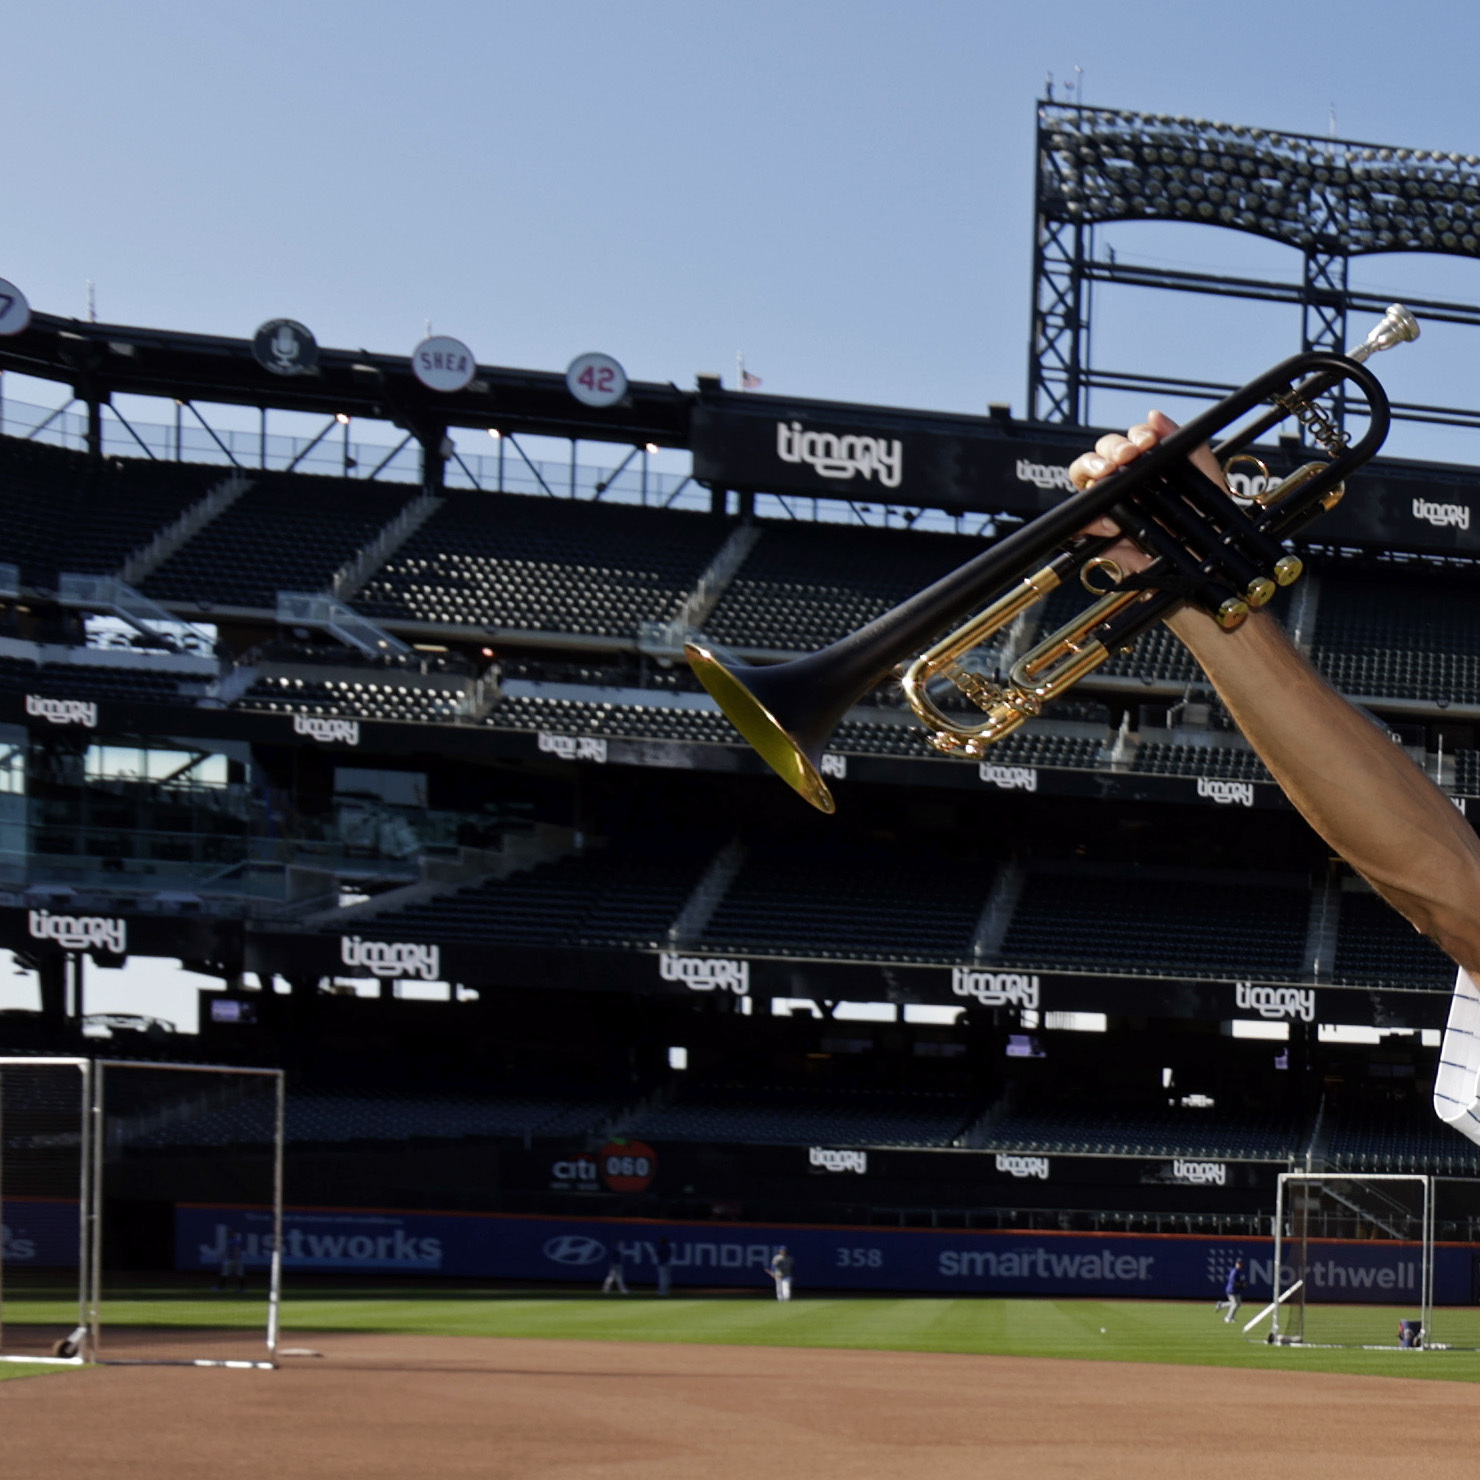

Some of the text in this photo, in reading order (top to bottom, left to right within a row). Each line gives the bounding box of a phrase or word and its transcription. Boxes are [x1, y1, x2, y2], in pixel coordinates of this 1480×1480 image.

[420, 351, 468, 373] SHEA
[577, 365, 615, 393] 42
[836, 1248, 883, 1268] 358
[938, 1248, 1154, 1281] smartwater
[1249, 1257, 1415, 1290] Northwell
